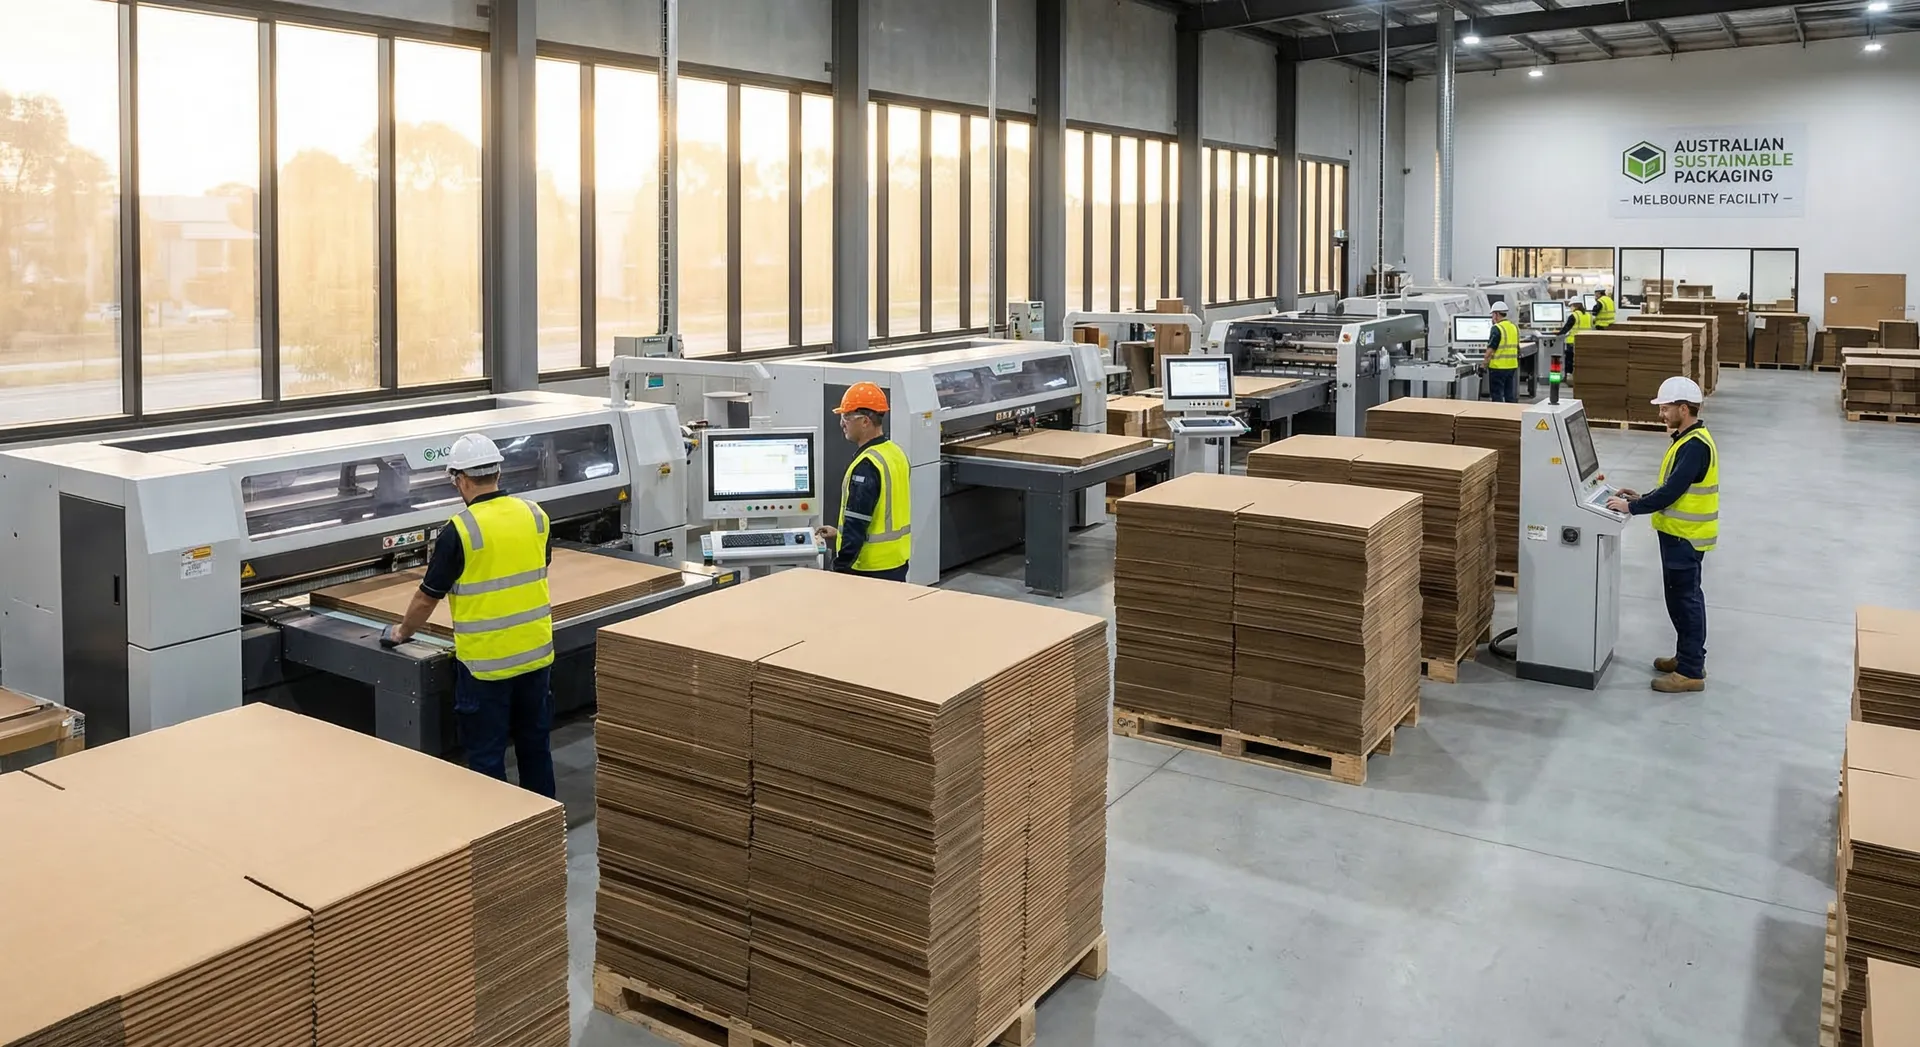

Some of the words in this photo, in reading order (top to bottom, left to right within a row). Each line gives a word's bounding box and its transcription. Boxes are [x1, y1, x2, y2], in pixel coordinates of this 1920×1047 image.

[1674, 138, 1784, 153] AUSTRALIAN
[1674, 153, 1793, 168] SUSTAINABLE
[1674, 169, 1773, 183] PACKAGING
[1633, 194, 1715, 205] MELBOURNE
[1719, 193, 1779, 204] FACILITY
